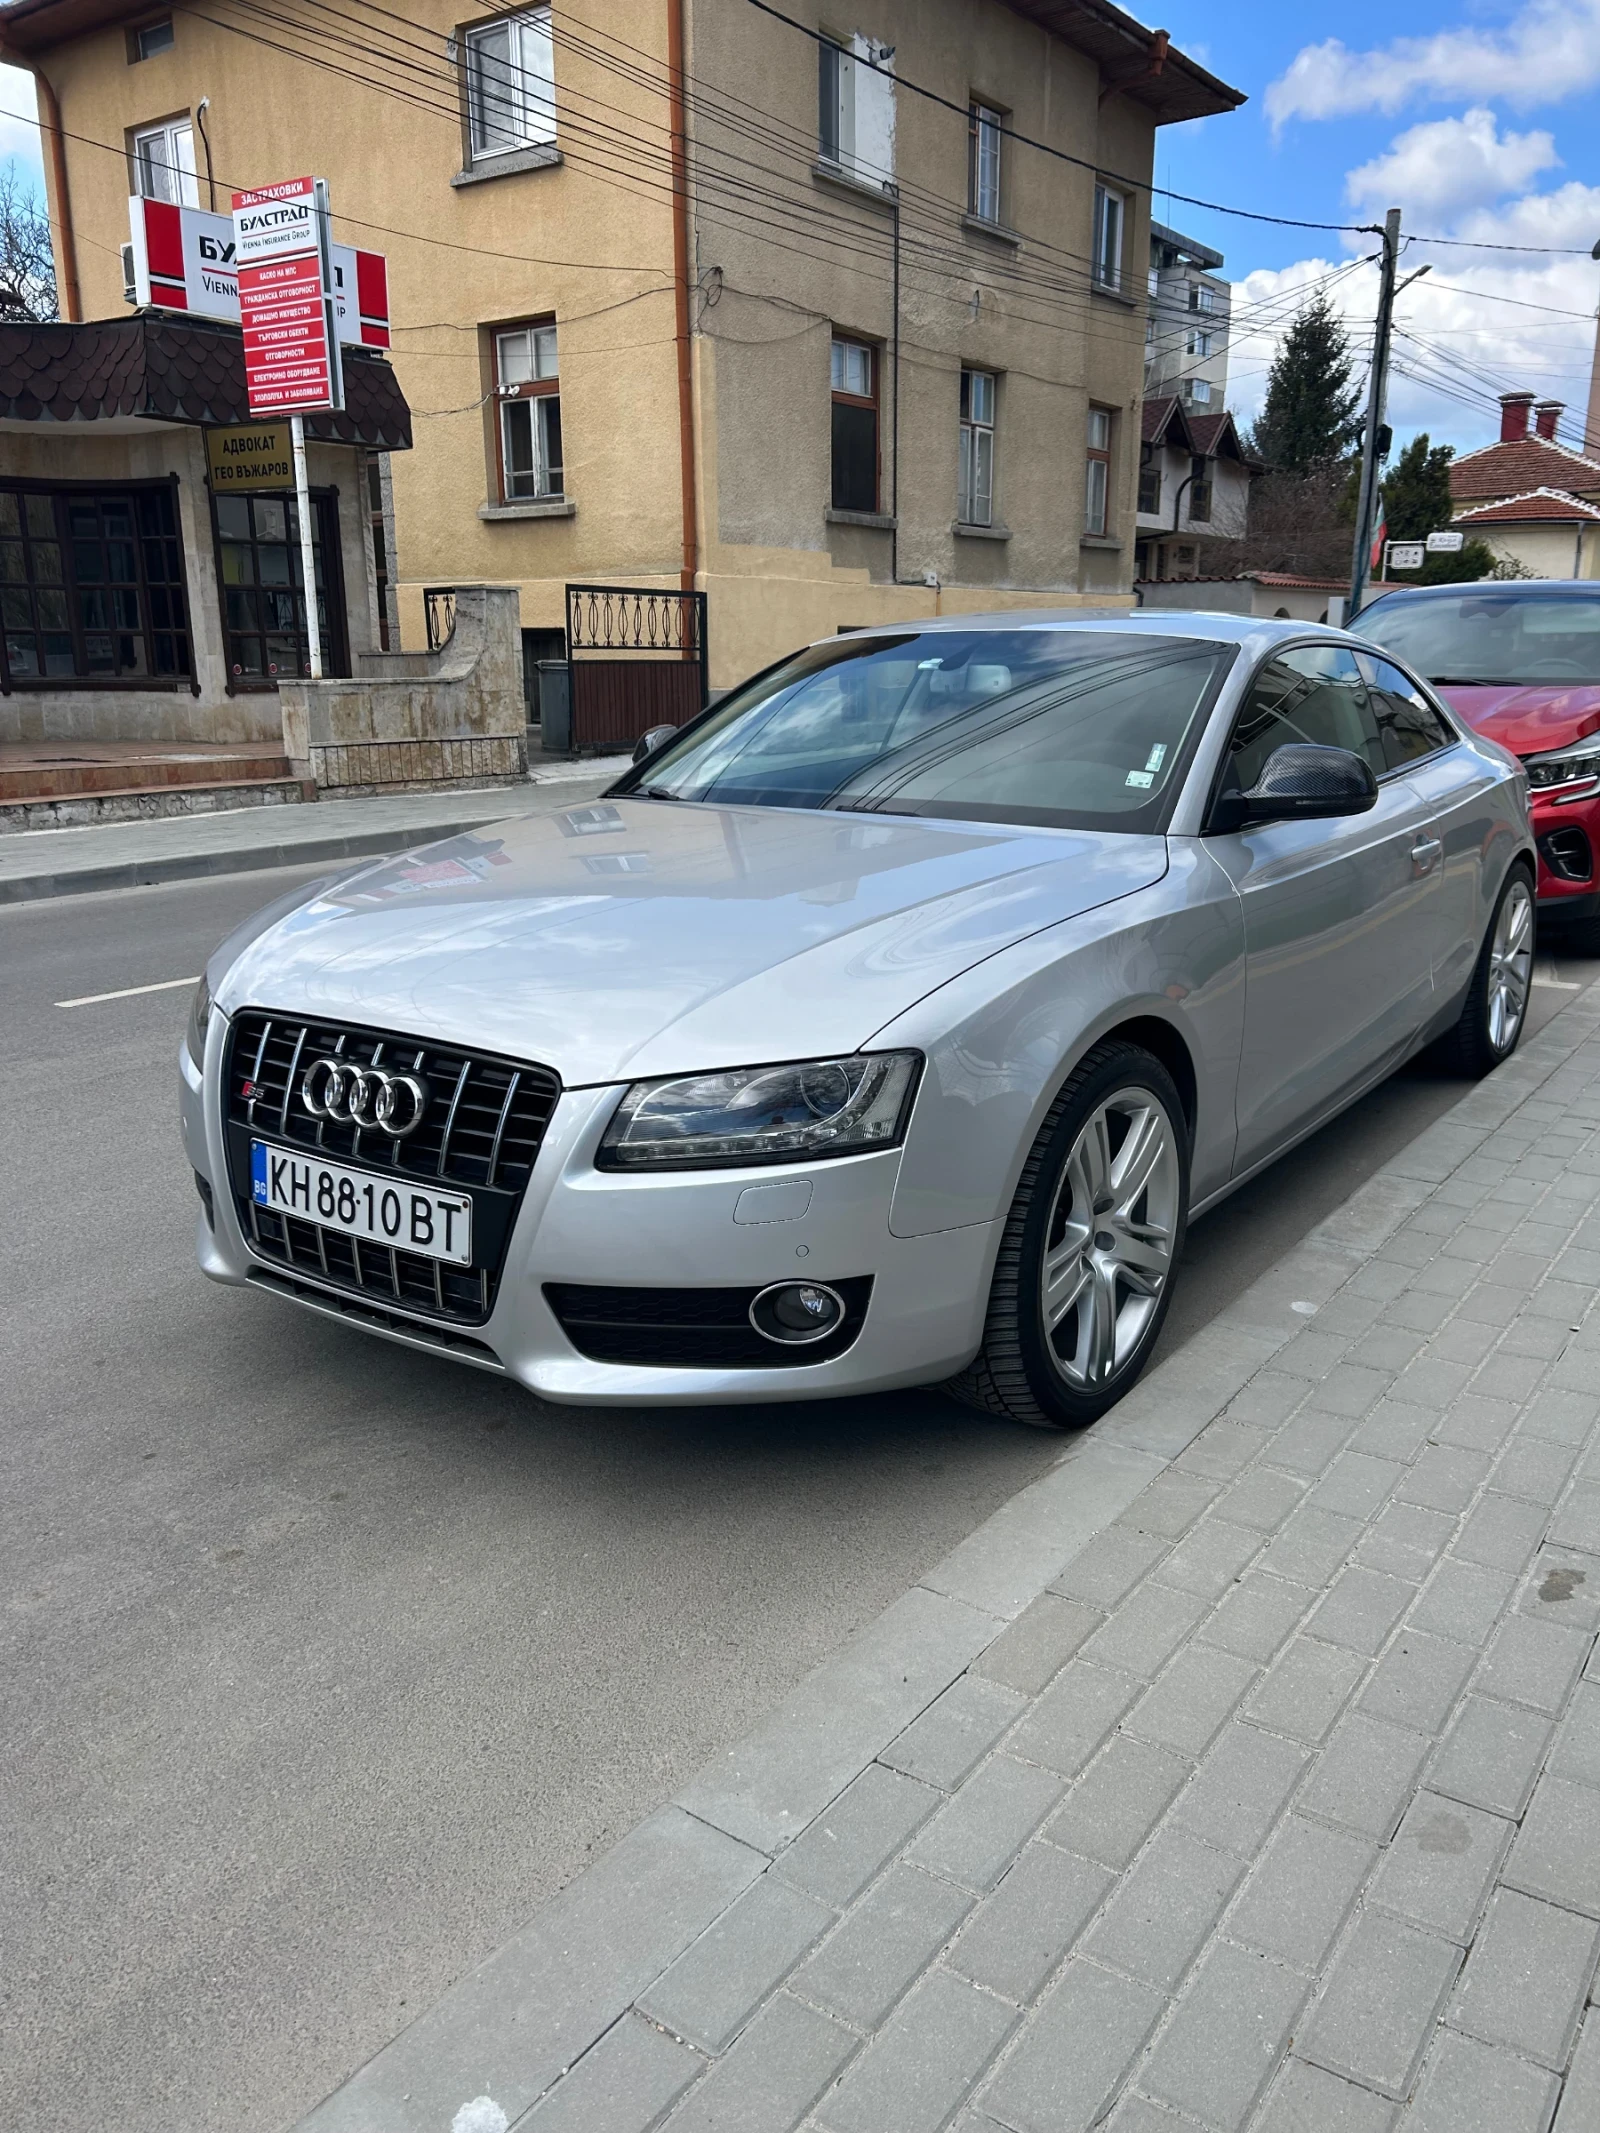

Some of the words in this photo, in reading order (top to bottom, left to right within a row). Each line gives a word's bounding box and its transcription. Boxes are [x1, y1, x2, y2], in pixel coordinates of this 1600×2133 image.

[241, 181, 304, 205] ЗАСТРАХОВКИ
[240, 205, 308, 231] БУЛСТРАД
[259, 269, 276, 280] КАСКО
[277, 269, 285, 278] НА
[285, 266, 297, 276] МПС
[202, 275, 240, 298] VIENN
[244, 291, 278, 304] ГРАЖДАНСКА
[279, 284, 316, 298] ОТГОВОРНОСТ
[252, 313, 279, 324] ДОМАШНО
[279, 306, 311, 319] ИМУЩЕСТВО
[258, 331, 288, 342] ТЪРГОВСКИ
[289, 327, 309, 337] ОБЕКТИ
[265, 348, 305, 361] ОТГОВОРНОСТИ
[254, 370, 286, 382] ЕЛЕКТРОННО
[287, 366, 321, 378] ОБОРУДВАНЕ
[254, 391, 283, 402] ЗЛОПОЛУКА
[285, 390, 290, 398] И
[290, 386, 324, 398] ЗАБОЛЯВАНЕ
[223, 435, 275, 456] АДВОКАТ
[214, 466, 234, 480] ГЕО
[236, 461, 289, 479] ВЪЖАРОВ
[254, 1179, 266, 1195] BG
